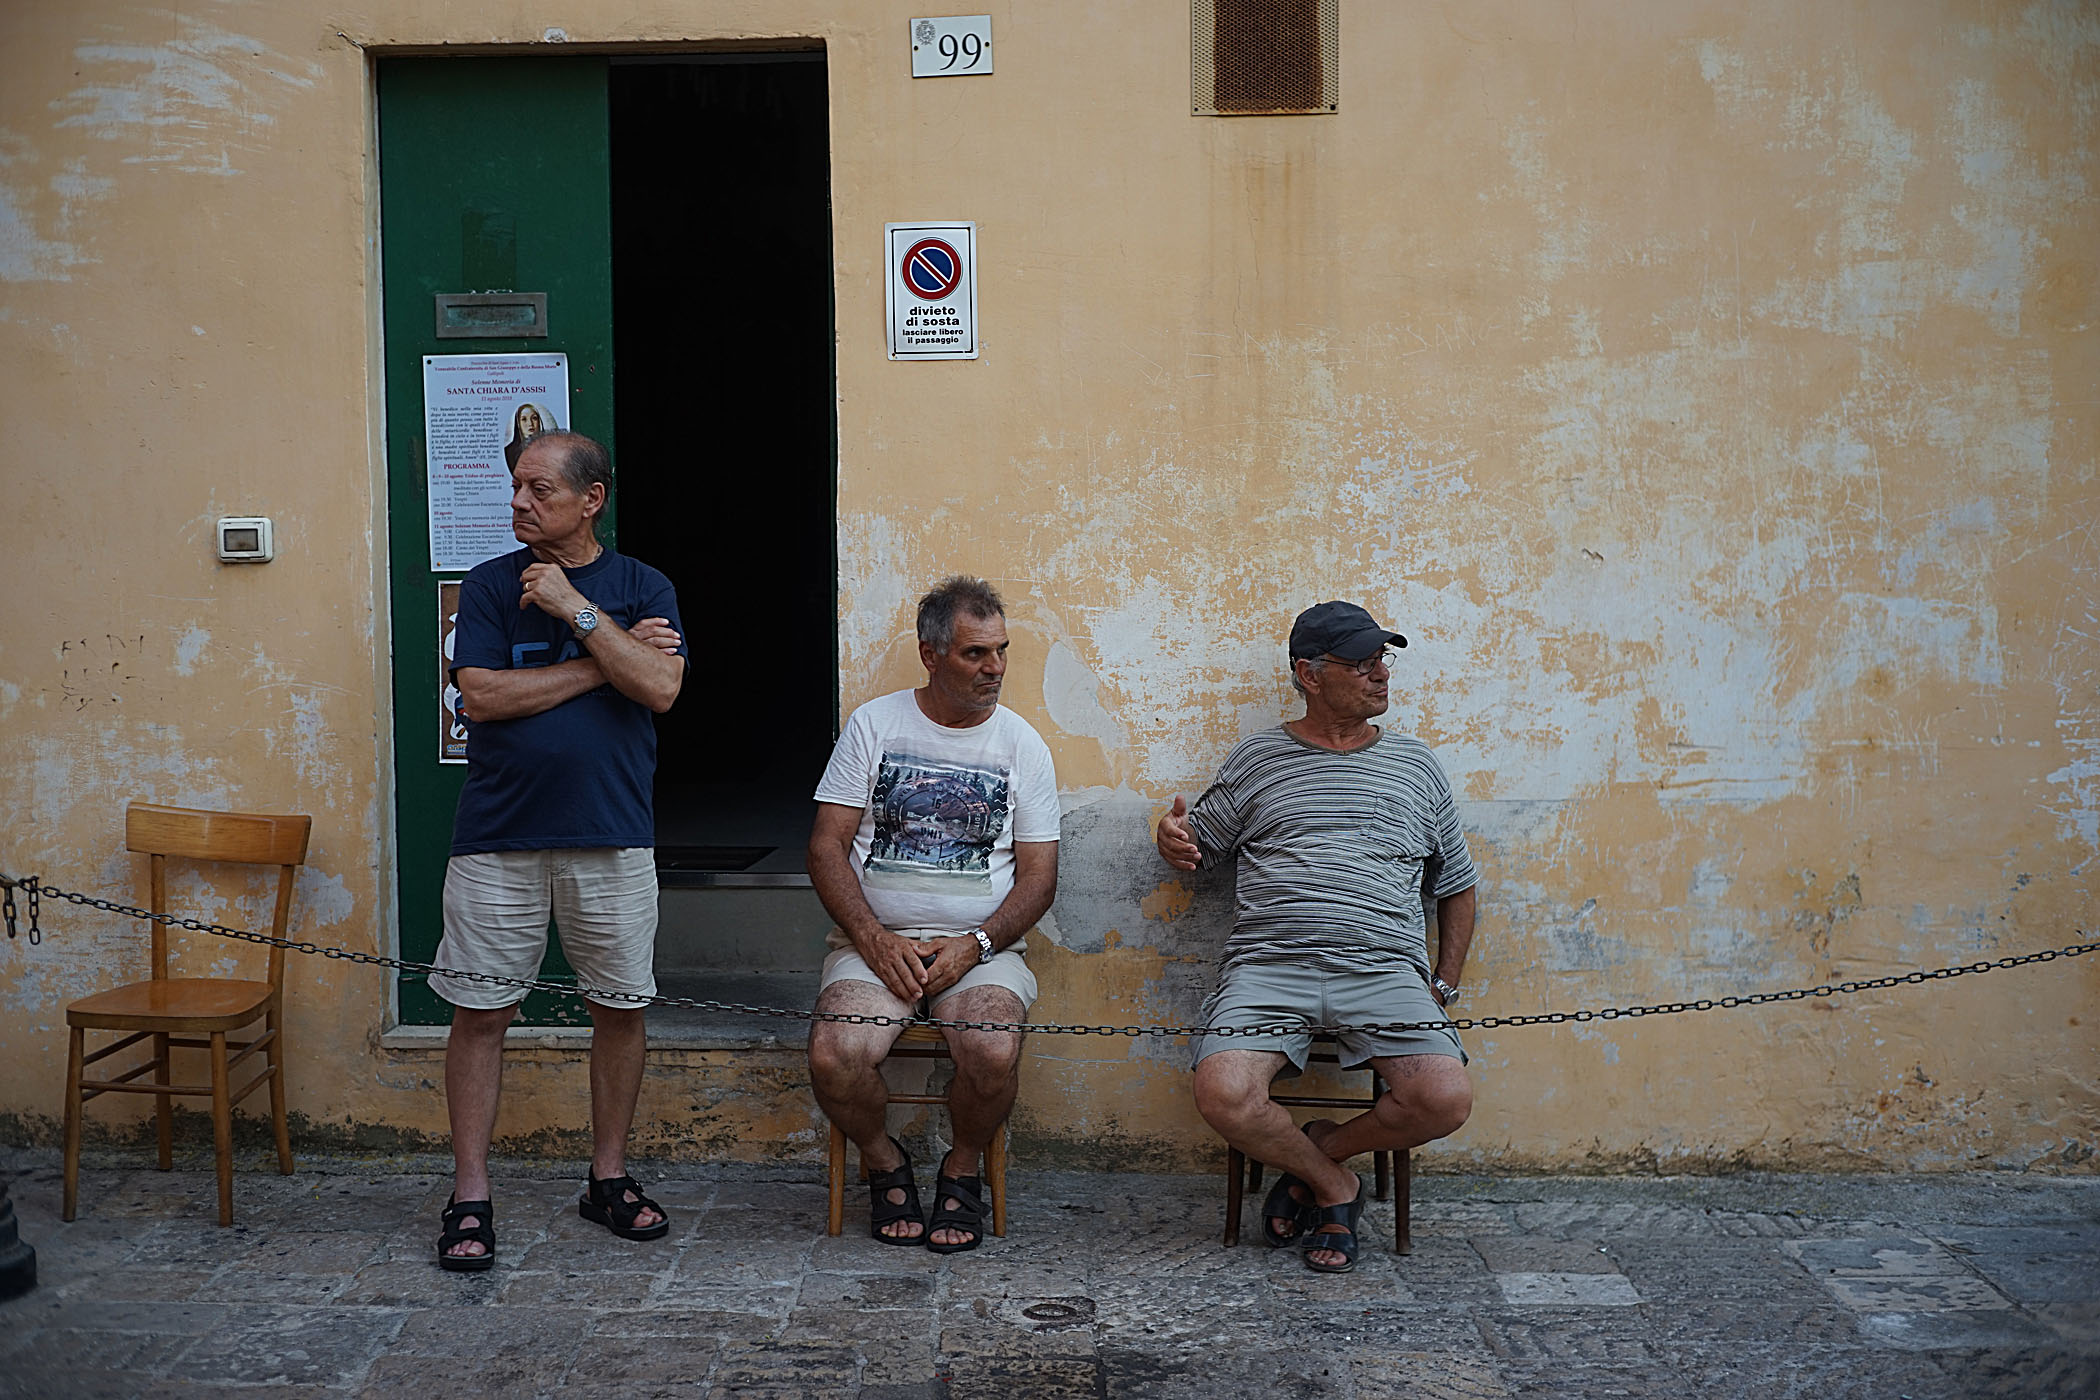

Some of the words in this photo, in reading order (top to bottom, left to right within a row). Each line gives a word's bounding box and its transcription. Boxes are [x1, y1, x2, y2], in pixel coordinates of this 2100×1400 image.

[938, 33, 981, 70] 99
[909, 306, 956, 315] divieto
[906, 317, 918, 326] di
[923, 317, 960, 326] sosta
[915, 336, 959, 345] passaggio
[932, 798, 943, 809] 16
[920, 827, 943, 840] UNIT
